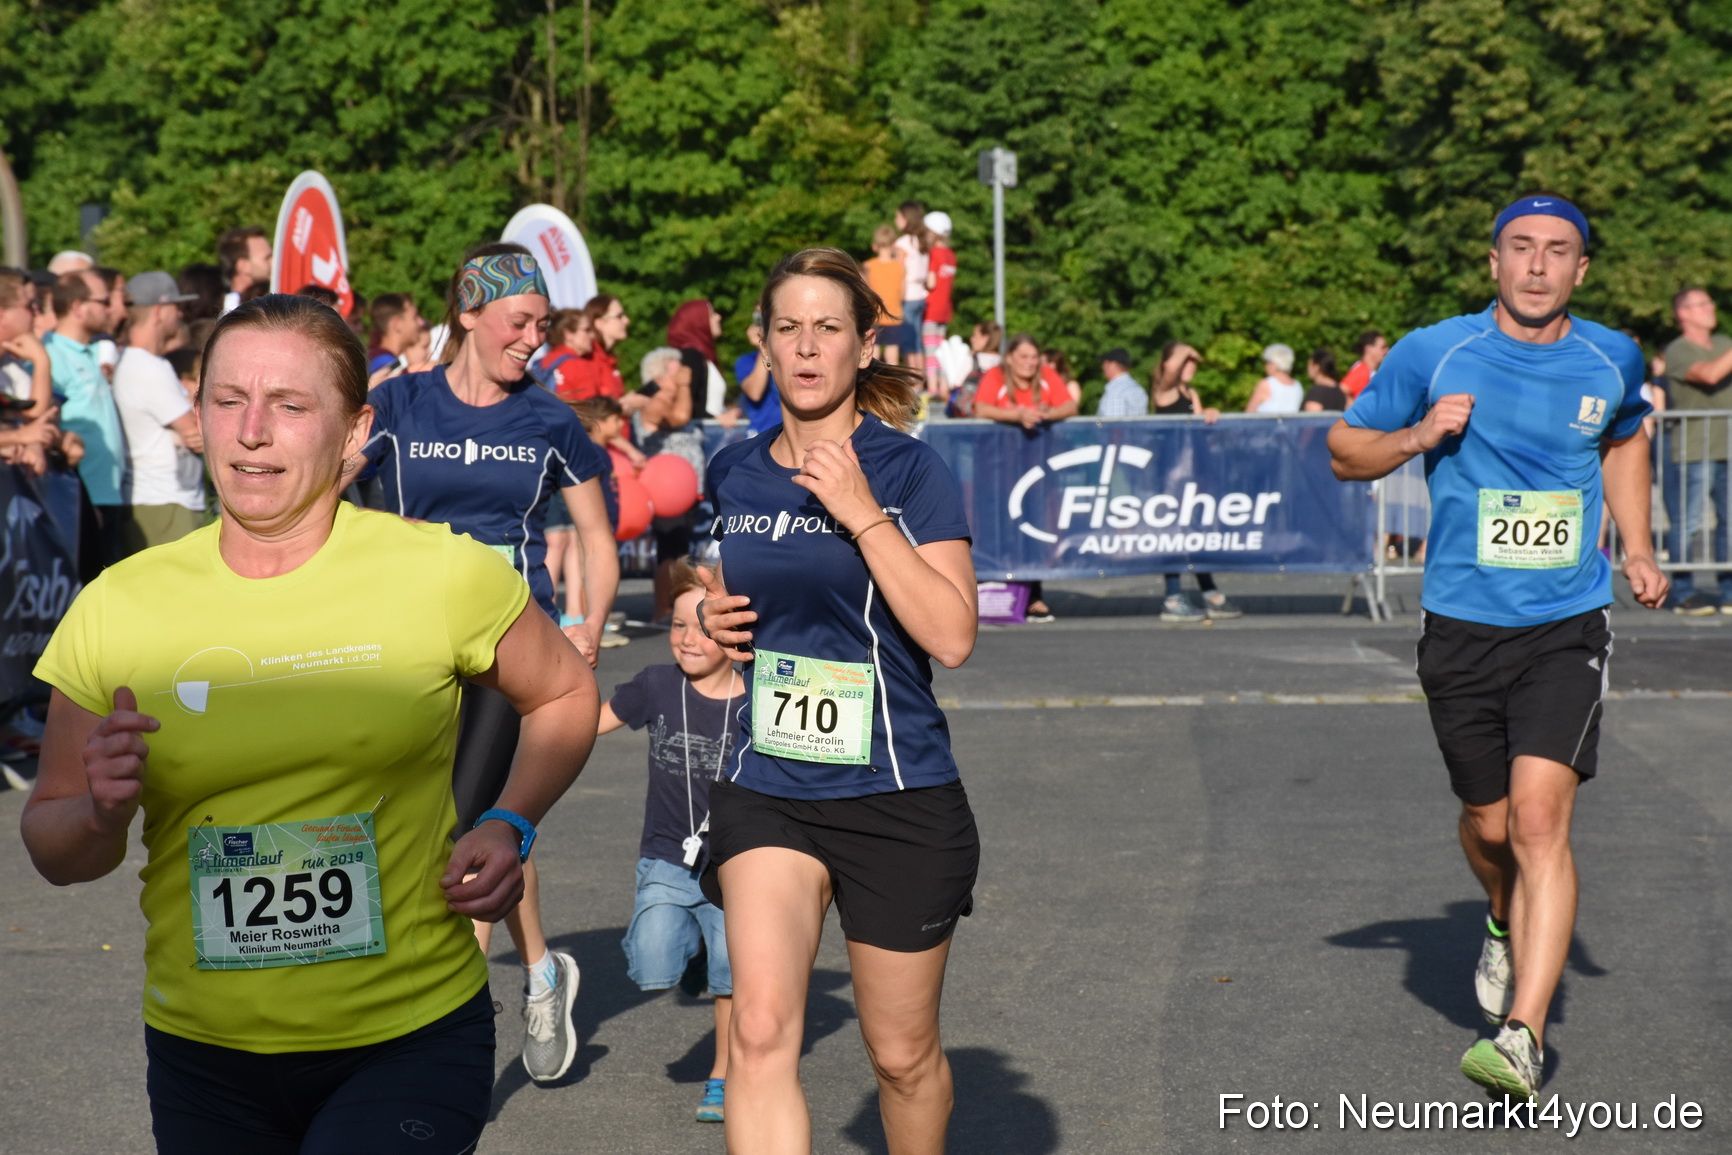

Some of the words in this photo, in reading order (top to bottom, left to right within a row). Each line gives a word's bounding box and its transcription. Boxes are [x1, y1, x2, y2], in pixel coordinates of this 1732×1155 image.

[409, 441, 462, 459] EURO
[481, 445, 537, 463] POLES
[1057, 482, 1281, 529] Fischer
[724, 514, 771, 535] EURO
[791, 516, 852, 534] POLE
[1491, 518, 1569, 546] 2026
[1078, 531, 1263, 554] AUTOMOBILE
[1498, 547, 1538, 555] Sebastian
[260, 653, 303, 666] Kliniken
[306, 650, 323, 659] des
[326, 643, 382, 656] Landkreises
[292, 656, 344, 671] Neumarkt
[768, 671, 811, 687] firmenlauf
[838, 690, 864, 699] 2019
[773, 690, 838, 734] 710
[765, 737, 791, 750] Europoles
[792, 742, 812, 751] GmbH
[767, 727, 805, 742] Lehmeier
[807, 735, 844, 746] Carolin
[301, 824, 334, 833] Gesunde
[213, 850, 284, 868] firmenlauf
[330, 851, 364, 867] 2019
[213, 866, 243, 874] neumarkt
[212, 868, 353, 928] 1259
[229, 929, 268, 944] Meier
[272, 923, 341, 941] Roswitha
[239, 944, 281, 955] Klinikum
[283, 938, 332, 952] Neumarkt
